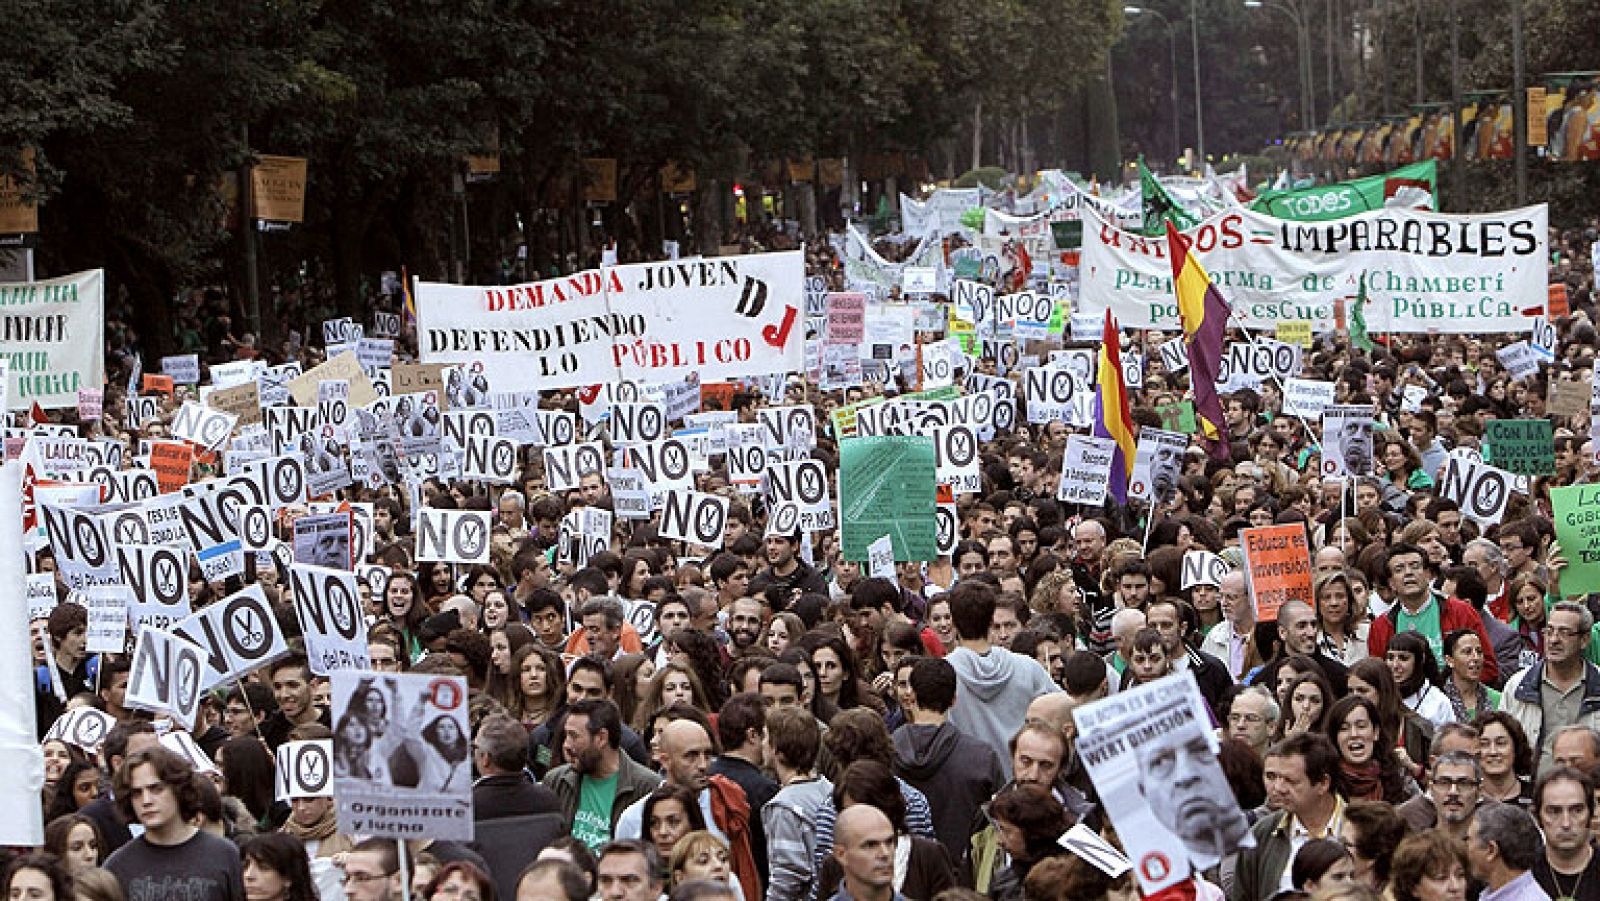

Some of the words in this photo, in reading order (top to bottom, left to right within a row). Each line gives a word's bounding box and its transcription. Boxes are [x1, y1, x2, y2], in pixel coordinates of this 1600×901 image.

[1281, 218, 1537, 257] IMPARABLES
[486, 270, 623, 311] DEMANDA
[640, 260, 739, 291] JOVEN
[376, 313, 398, 335] NO
[1000, 293, 1034, 322] NO
[428, 314, 646, 353] DEFENDIENDO
[539, 352, 578, 377] LO
[612, 338, 751, 368] PÚBLICO
[923, 359, 949, 380] NO
[1231, 346, 1274, 374] NO
[1028, 370, 1075, 403] NO
[172, 402, 229, 445] NO
[319, 400, 346, 426] NO
[613, 404, 662, 441] NO
[760, 408, 813, 445] NO
[952, 394, 991, 424] NO
[443, 412, 494, 449] NO
[535, 413, 573, 445] NO
[464, 437, 515, 477] NO
[546, 445, 603, 488] NO
[629, 440, 689, 483] NO
[729, 446, 765, 474] NO
[767, 463, 825, 504] NO
[1442, 458, 1505, 517] NO
[42, 504, 105, 567] NO
[179, 489, 247, 551] NO
[419, 512, 487, 559] NO
[661, 489, 724, 543] NO
[1248, 534, 1289, 551] Educar
[117, 548, 183, 605] NO
[1181, 552, 1230, 585] NO
[291, 568, 357, 641] NO
[172, 597, 274, 675] NO
[130, 631, 199, 715] NO
[277, 742, 330, 797] NO
[1084, 737, 1126, 766] WERT
[352, 820, 363, 831] y
[368, 819, 424, 833] lucha
